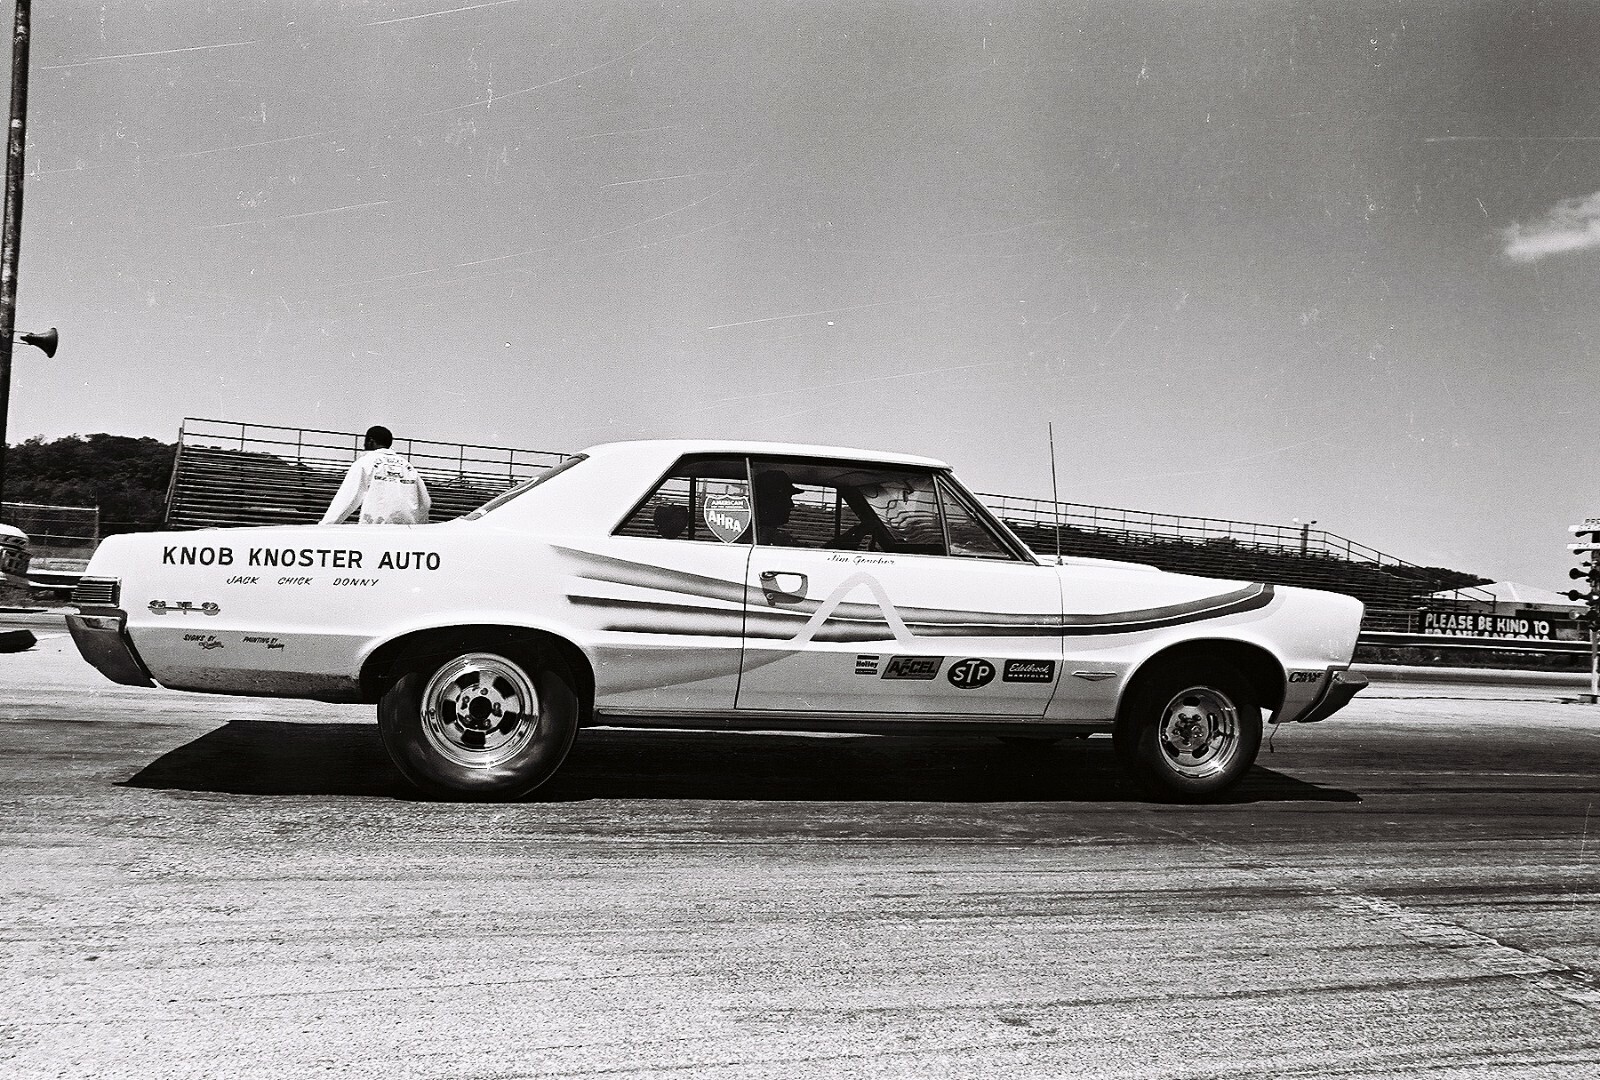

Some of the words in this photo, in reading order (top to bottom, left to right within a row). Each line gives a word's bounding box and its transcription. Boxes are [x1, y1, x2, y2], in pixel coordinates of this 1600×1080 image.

[708, 510, 743, 533] AHRA
[162, 546, 235, 566] KNOB
[248, 547, 364, 569] KNOSTER
[377, 551, 442, 571] AUTO
[226, 575, 261, 585] JACK
[277, 576, 314, 586] CHICK
[332, 577, 380, 587] DONNY
[1425, 613, 1474, 630] PLEASE
[1477, 616, 1493, 631] BE
[1497, 618, 1529, 634] KIND
[1532, 620, 1550, 635] TO
[855, 660, 879, 669] Holley
[952, 660, 991, 684] STP
[1009, 663, 1050, 674] Edelbrock
